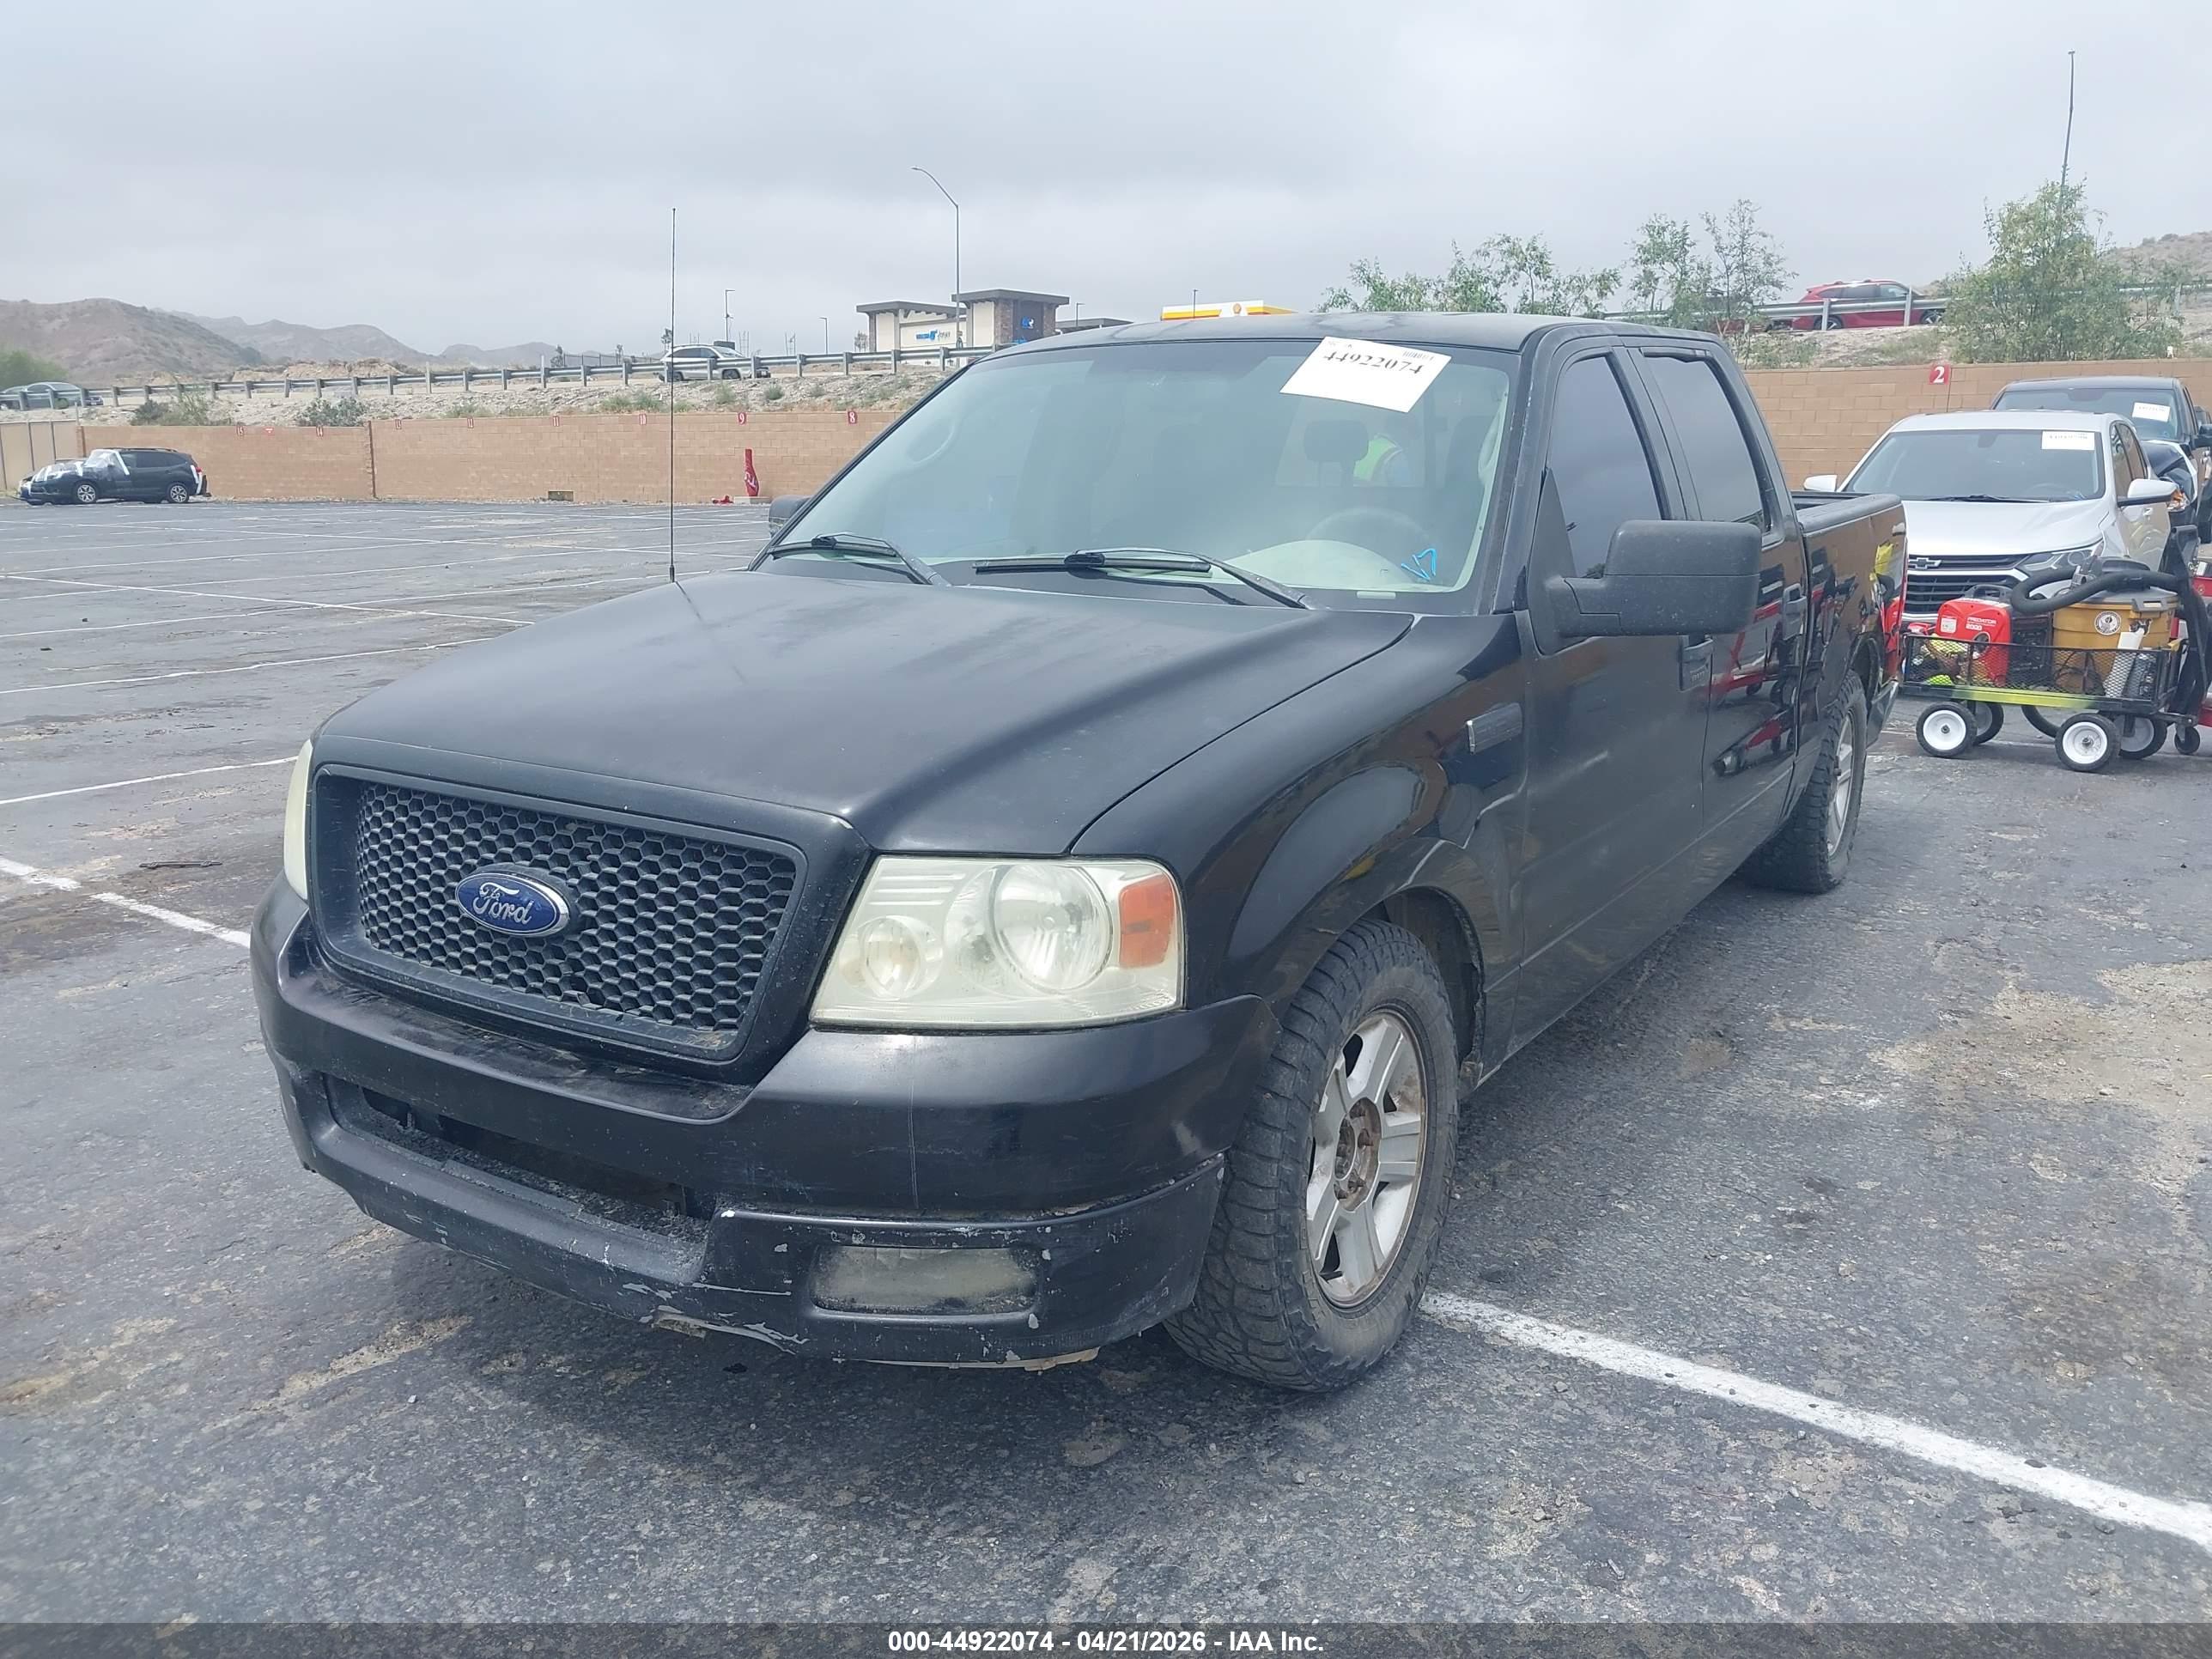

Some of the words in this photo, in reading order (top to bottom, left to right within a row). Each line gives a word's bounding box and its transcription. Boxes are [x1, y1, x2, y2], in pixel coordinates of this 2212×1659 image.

[1323, 350, 1425, 374] 44922074
[1933, 366, 1945, 384] 2
[738, 412, 745, 424] 9
[848, 411, 857, 423] 8
[473, 882, 534, 924] Ford
